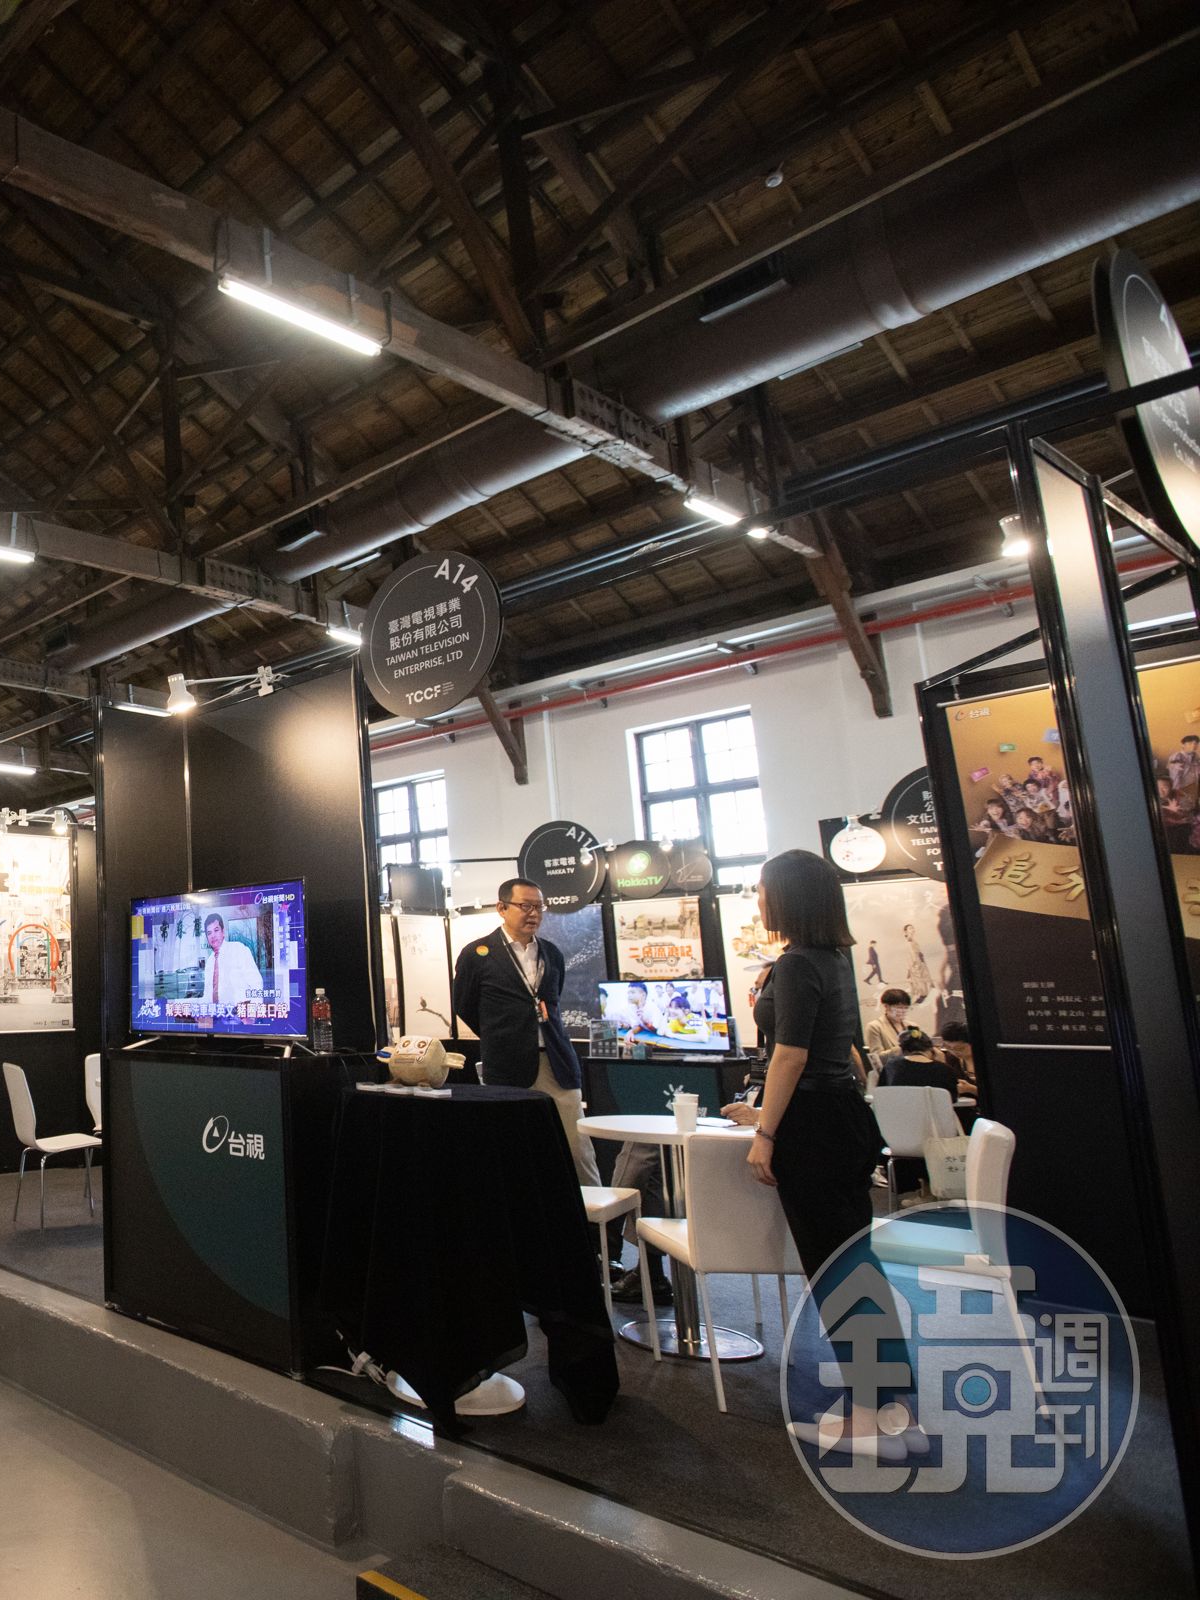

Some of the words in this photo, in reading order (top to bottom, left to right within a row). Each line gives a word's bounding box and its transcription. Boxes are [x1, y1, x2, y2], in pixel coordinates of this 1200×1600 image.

[434, 558, 479, 594] A14
[388, 597, 462, 635] 臺灣電視事業
[389, 615, 463, 651] 股份有限公司
[385, 648, 418, 666] TAIWAN
[420, 632, 470, 656] TELEVISION
[393, 658, 445, 679] ENTERPRISE,
[446, 650, 463, 663] LTD
[405, 684, 442, 705] TCCF
[906, 812, 936, 825] 文化
[544, 856, 576, 868] 客家電視
[616, 875, 663, 888] HakkaTV
[547, 896, 571, 905] TCCF
[165, 1002, 235, 1018] 幫美軍洗車學英文
[236, 1002, 289, 1019] 豬圈練口說
[228, 1130, 265, 1160] 台視
